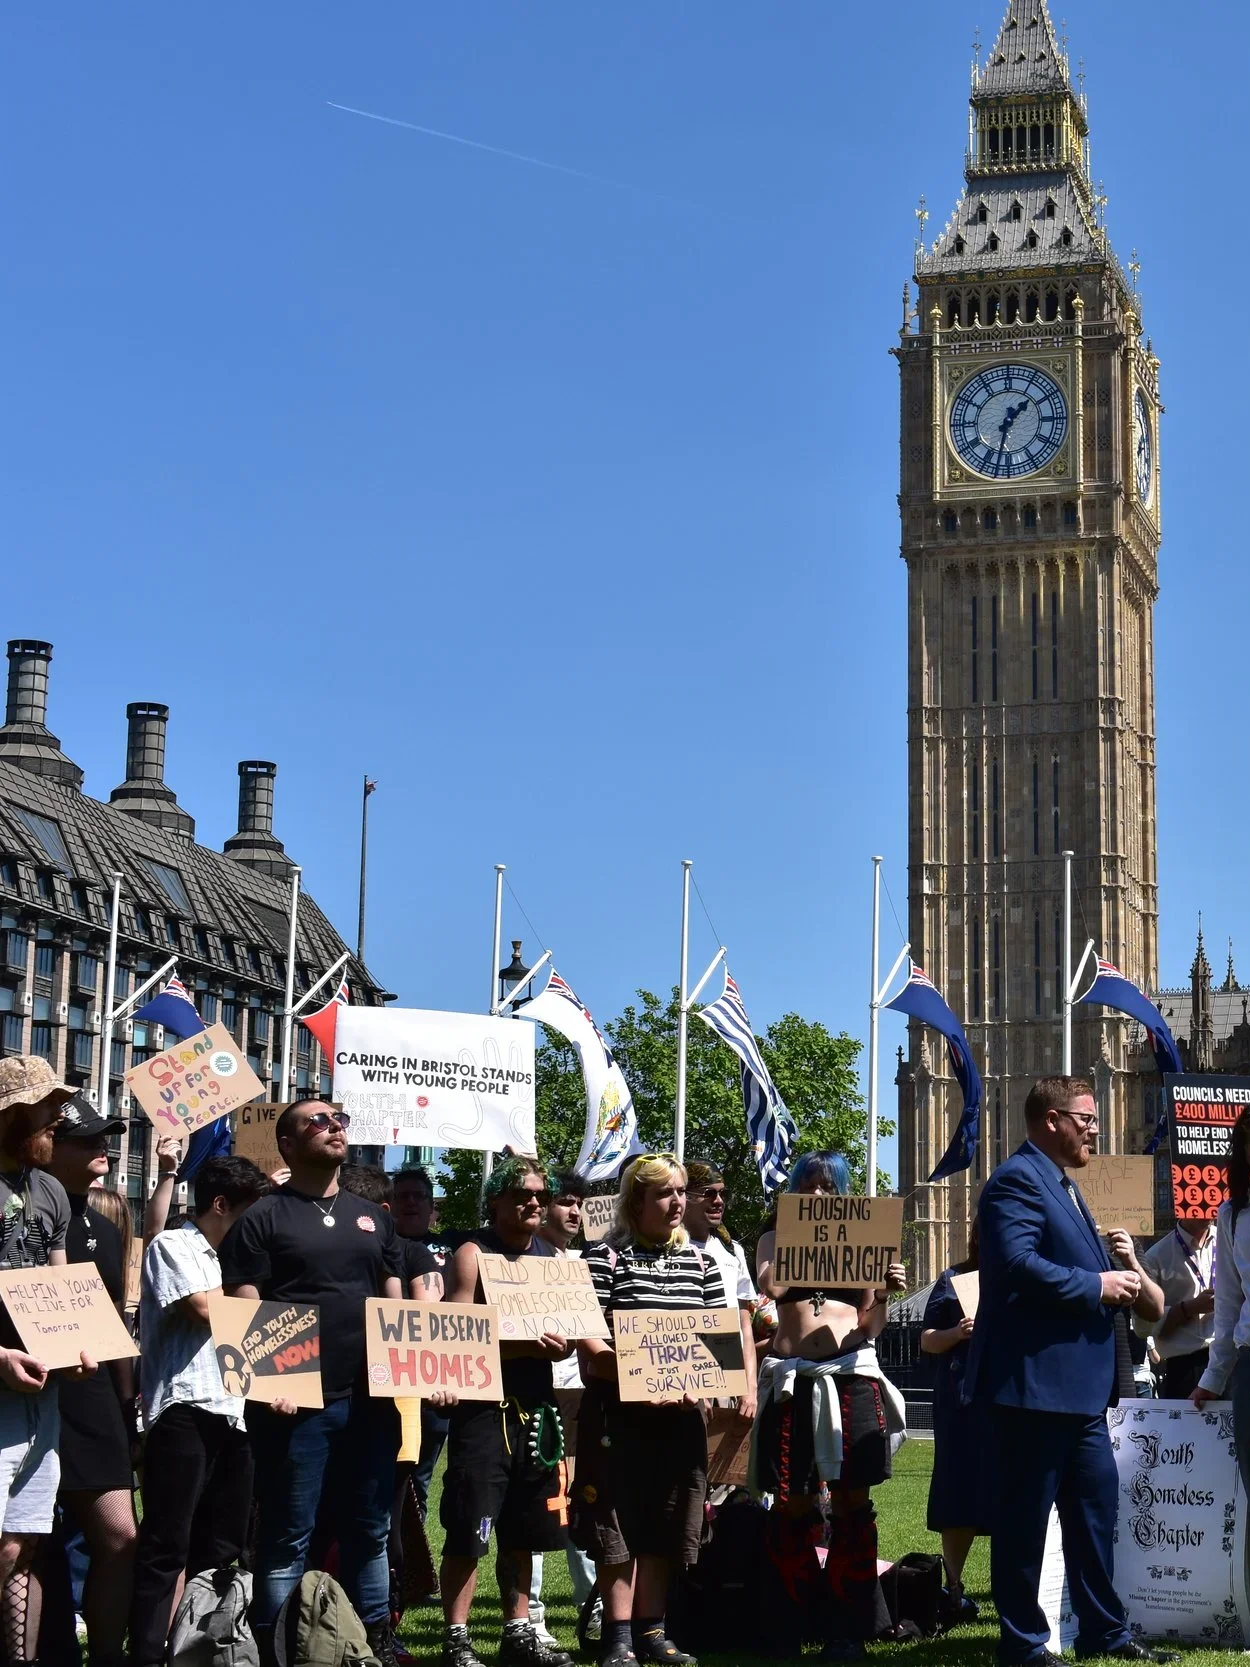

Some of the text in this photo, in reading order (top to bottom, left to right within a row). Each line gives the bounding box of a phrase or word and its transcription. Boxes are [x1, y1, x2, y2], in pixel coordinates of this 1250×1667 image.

[149, 1034, 213, 1086] Stand
[336, 1052, 532, 1085] CARING IN BRISTOL STANDS
[361, 1069, 510, 1095] WITH YOUNG PEOPLE
[1173, 1086, 1224, 1102] COUNCILS
[335, 1090, 407, 1110] YOUTH
[1175, 1102, 1206, 1119] £400
[242, 1106, 277, 1125] GIVE
[344, 1109, 429, 1129] HAPTER
[1176, 1126, 1188, 1138] TO
[1189, 1126, 1209, 1139] HELP
[1212, 1127, 1229, 1139] END
[798, 1198, 871, 1221] HOUSING
[814, 1223, 848, 1242] IS A
[484, 1258, 592, 1282] END YOUTH
[776, 1245, 897, 1283] HUMAN RIGHT
[6, 1278, 104, 1300] HELPIN YOUNG
[14, 1295, 94, 1314] PPL LIVE FOR
[488, 1290, 597, 1317] HOMELESSNESS
[242, 1306, 298, 1351] END YOUTH
[377, 1307, 491, 1345] WE DESERVE
[522, 1314, 586, 1338] NOW!
[619, 1314, 721, 1334] WE SHOULD BE
[247, 1309, 318, 1365] HOMELESSNESS
[640, 1332, 688, 1346] ALLOWED
[388, 1347, 492, 1390] HOMES
[628, 1368, 643, 1377] NOT
[657, 1366, 679, 1375] JUST
[1127, 1429, 1195, 1473] Youth
[1122, 1470, 1215, 1510] Homeless
[1127, 1510, 1205, 1553] Chapter
